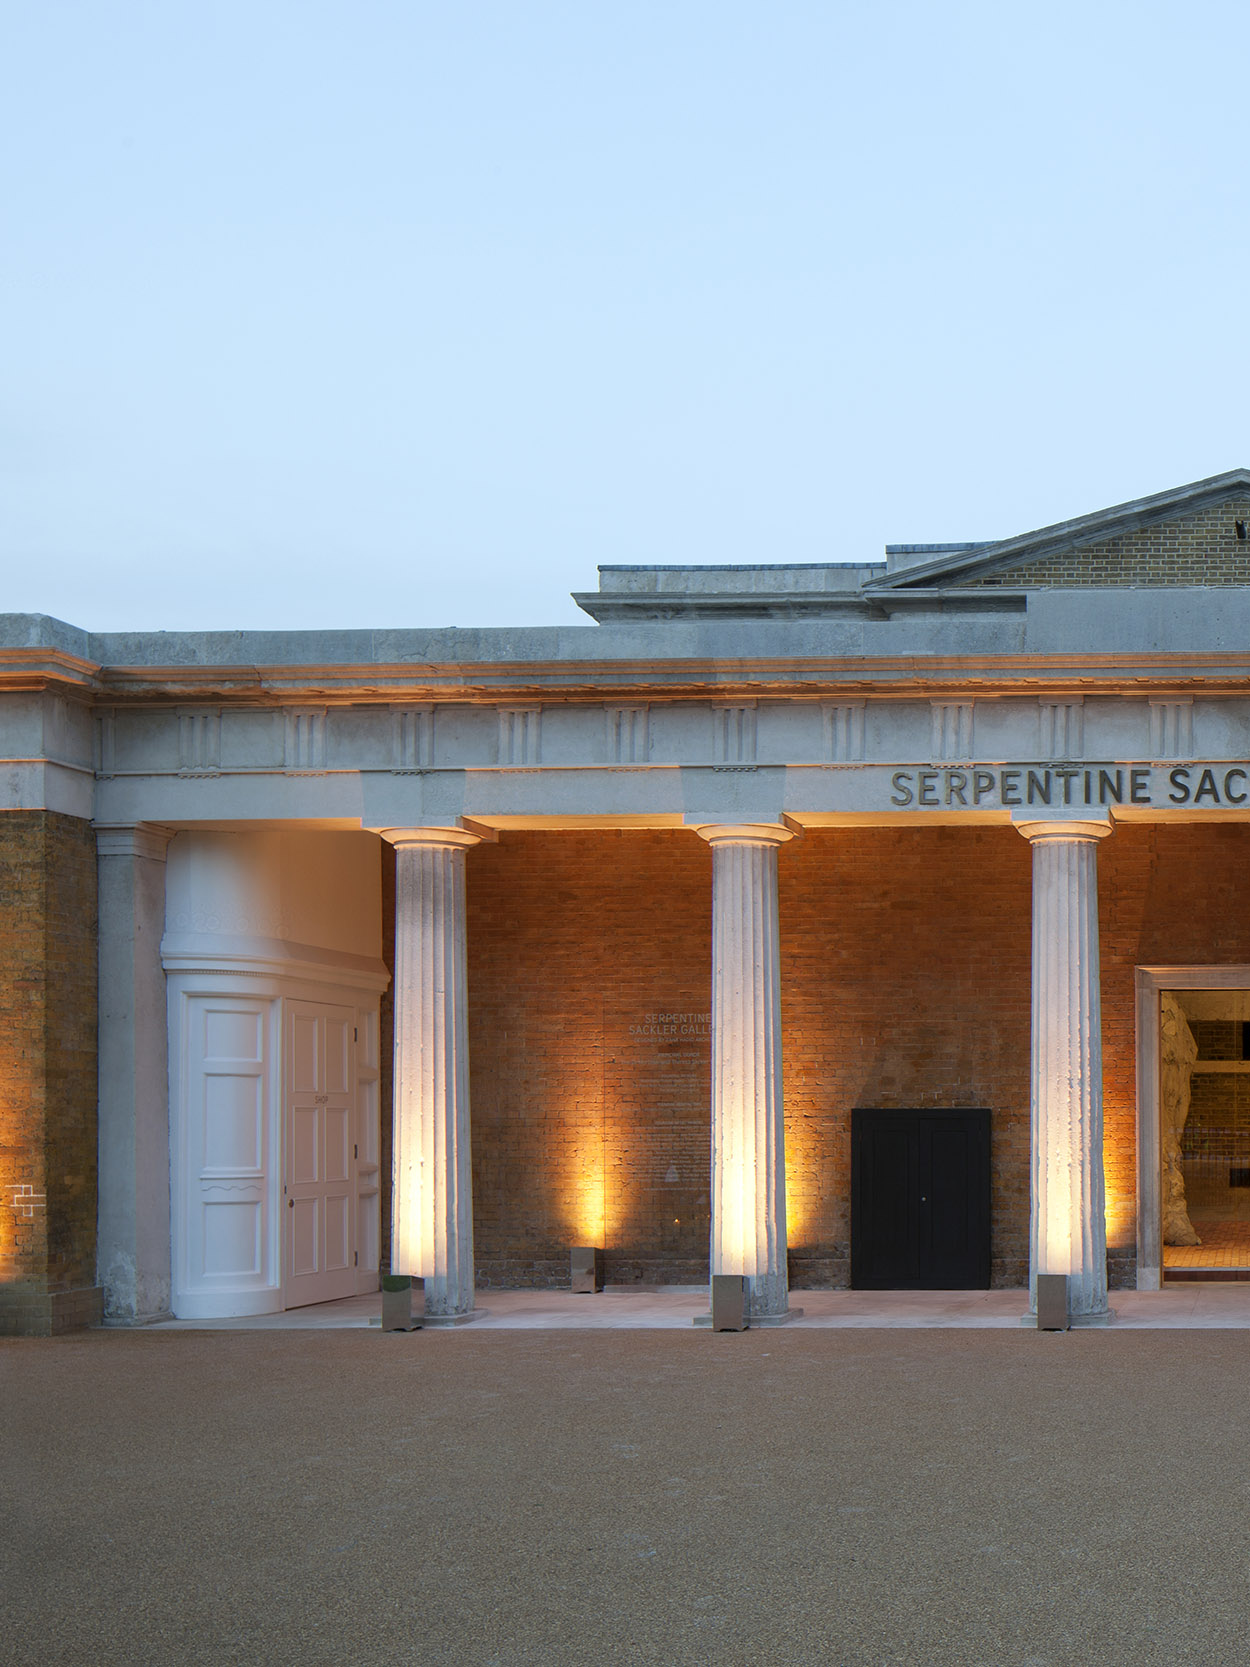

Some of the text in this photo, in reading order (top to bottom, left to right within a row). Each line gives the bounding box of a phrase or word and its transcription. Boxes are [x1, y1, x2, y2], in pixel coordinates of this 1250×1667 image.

[891, 768, 1151, 806] SERPENTINE
[645, 1013, 711, 1024] SERPENTINE
[629, 1024, 677, 1035] SACKLER
